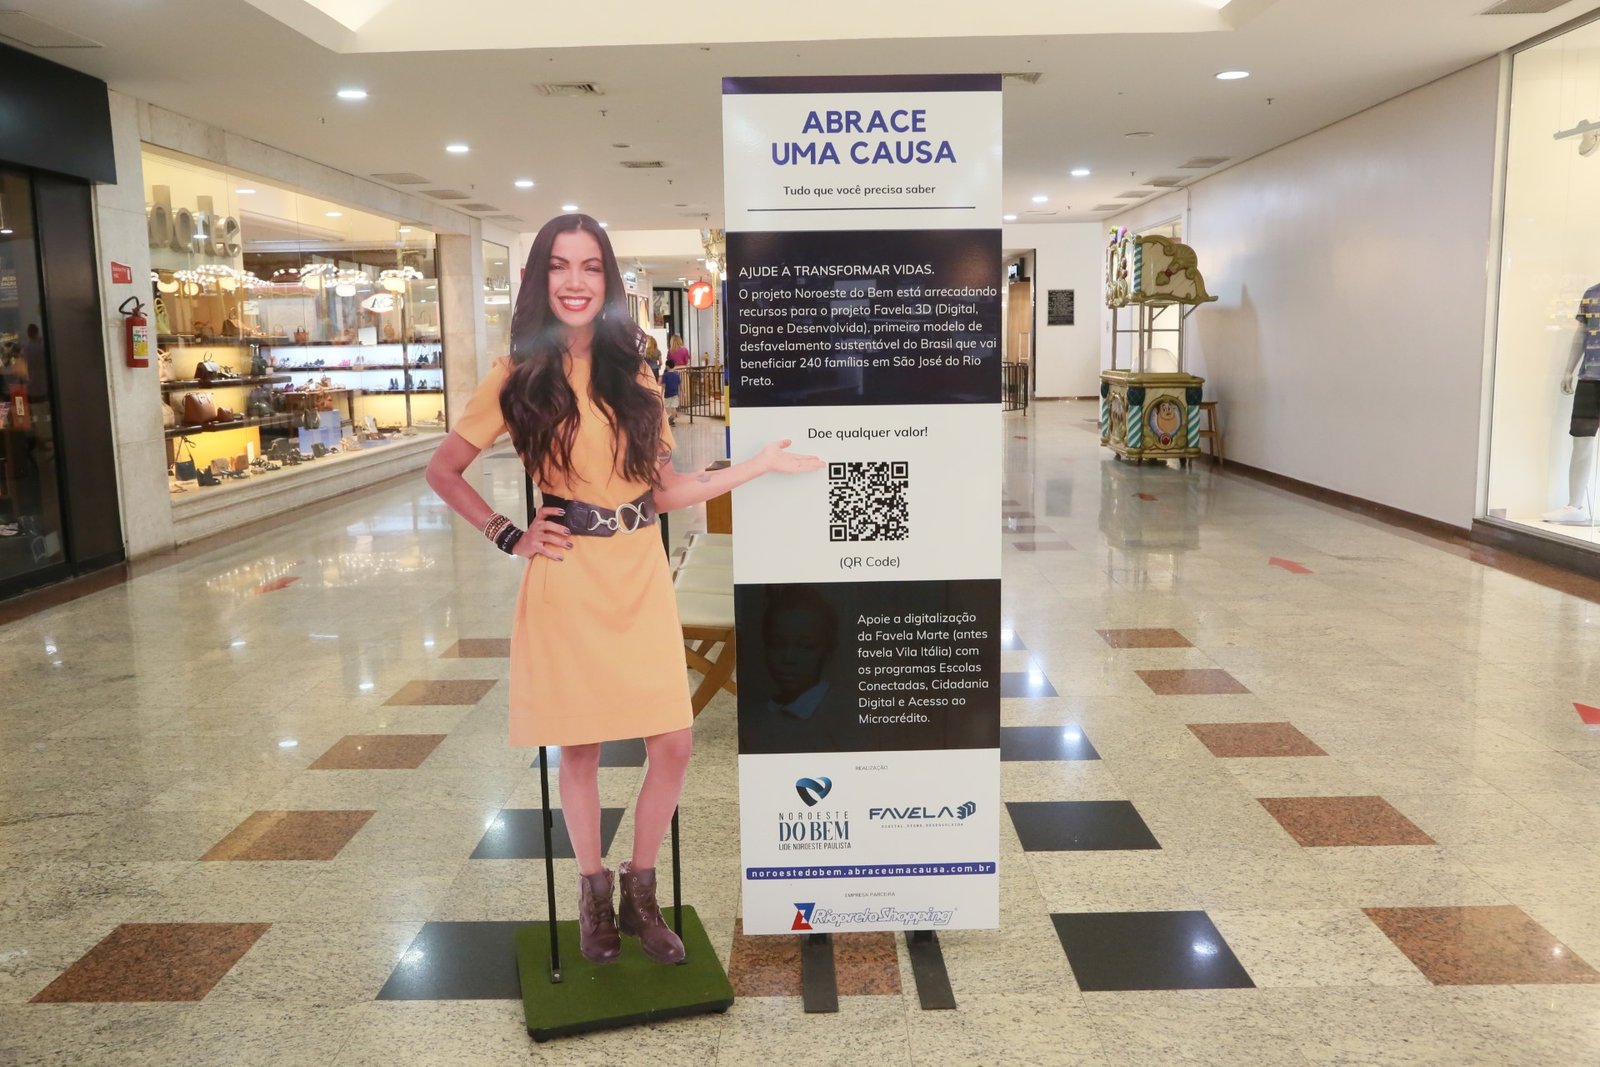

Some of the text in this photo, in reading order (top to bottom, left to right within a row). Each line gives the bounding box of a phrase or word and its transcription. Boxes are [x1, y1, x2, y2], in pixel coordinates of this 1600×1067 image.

[802, 109, 927, 134] ABRACE
[771, 140, 957, 165] UMA CAUSA
[783, 184, 936, 197] Tudo que você precisa saber
[739, 264, 935, 279] AJUDE A TRANSFORMAR VIDAS.
[739, 285, 997, 302] O projeto Noroeste do Bem está arrecadando
[739, 302, 979, 319] recursos para o projeto Favela 3D (Digital,
[739, 320, 983, 337] Digna e Desenvolvida), primeiro modelo de
[740, 337, 997, 352] desfavelamento sustentável do Brasil que vai
[740, 354, 981, 369] beneficiar 240 famílias em São José do Rio
[740, 375, 775, 387] Preto.
[807, 426, 929, 441] Doe qualquer valor!
[839, 555, 901, 570] (QR Code)
[857, 612, 977, 627] Apoie a digitalização
[857, 629, 988, 642] da Favela Marte (antes
[857, 645, 980, 658] favela Vila Itália) com
[857, 662, 982, 677] os programas Escolas
[858, 678, 989, 692] Conectadas, Cidadania
[858, 696, 966, 710] Digital e Acesso ao
[858, 713, 931, 724] Microcrédito.
[778, 810, 849, 821] NOROESTE
[869, 806, 954, 821] FAVELA
[779, 820, 850, 842] DO BEM
[778, 841, 852, 851] LIDE NOROESTE PAULISTA
[751, 864, 992, 878] noroestedobem.abraceumacausa.com.br
